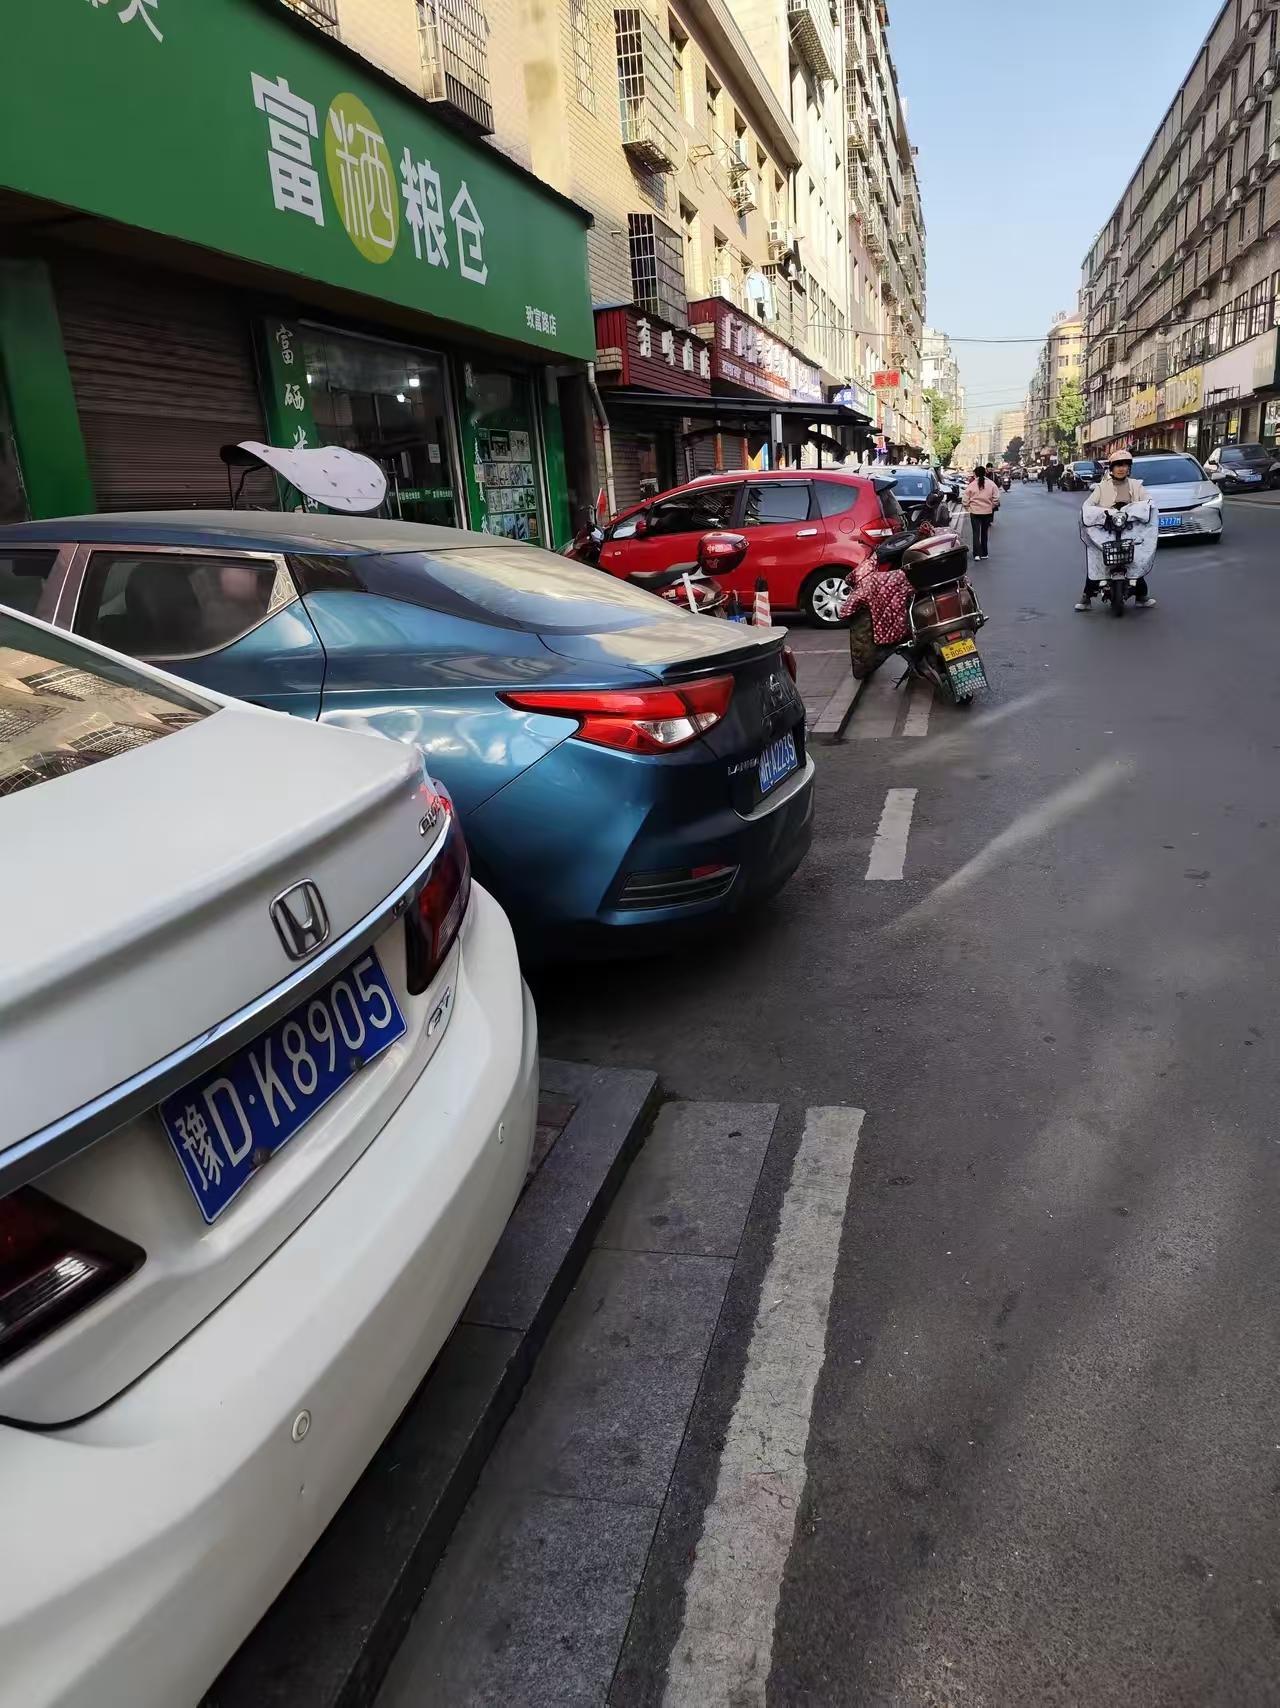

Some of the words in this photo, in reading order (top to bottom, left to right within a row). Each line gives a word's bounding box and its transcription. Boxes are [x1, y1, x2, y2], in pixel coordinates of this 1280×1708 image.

[525, 305, 557, 337] 致富路店
[174, 956, 393, 1191] 豫D·K8905
